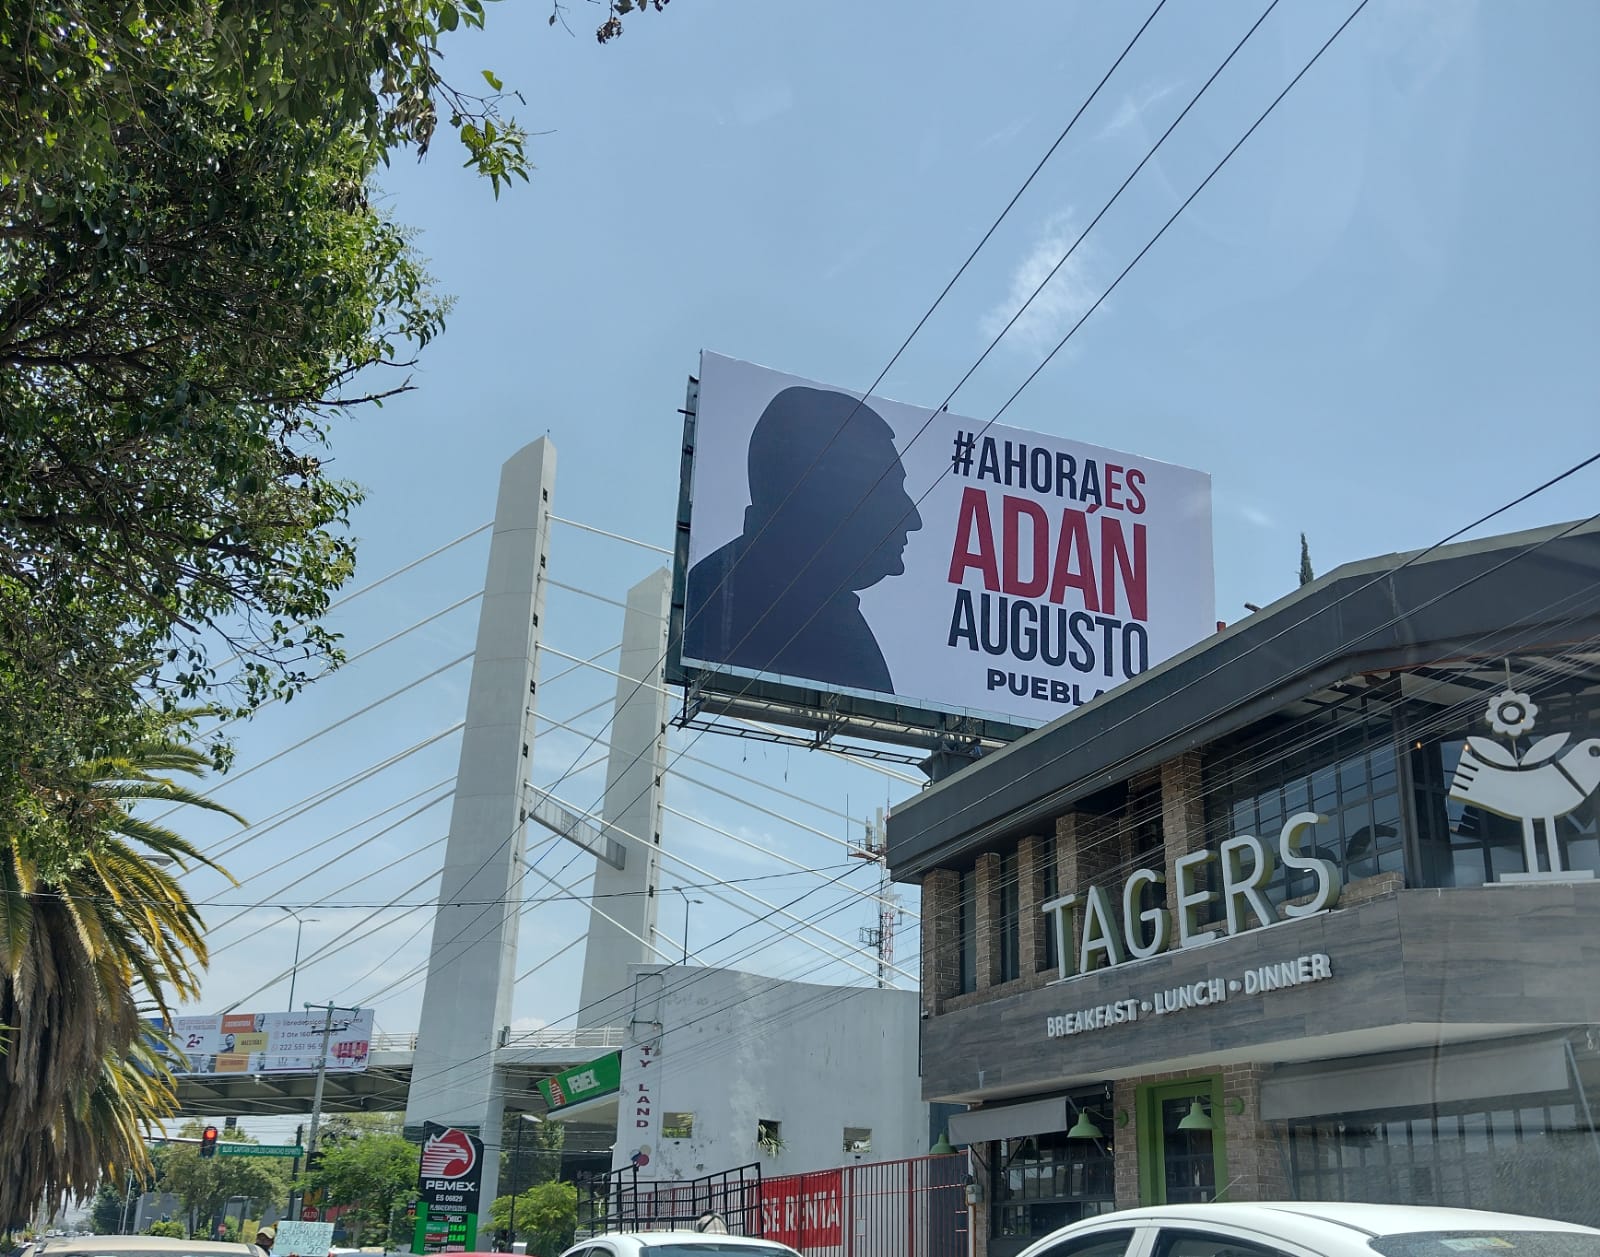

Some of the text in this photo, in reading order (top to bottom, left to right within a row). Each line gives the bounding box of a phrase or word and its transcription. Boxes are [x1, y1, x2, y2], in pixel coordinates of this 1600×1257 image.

[947, 486, 1148, 622] ADÁN
[947, 588, 1149, 680] AUGUSTO
[1041, 811, 1342, 980] TAGERS
[1047, 952, 1334, 1038] BREAKFAST LUNCH DINNER
[566, 1069, 601, 1095] PEMEX
[636, 1083, 651, 1129] LAND
[425, 1180, 475, 1191] PEMEX
[303, 1211, 318, 1219] ALTO
[761, 1189, 841, 1234] SE RENTA
